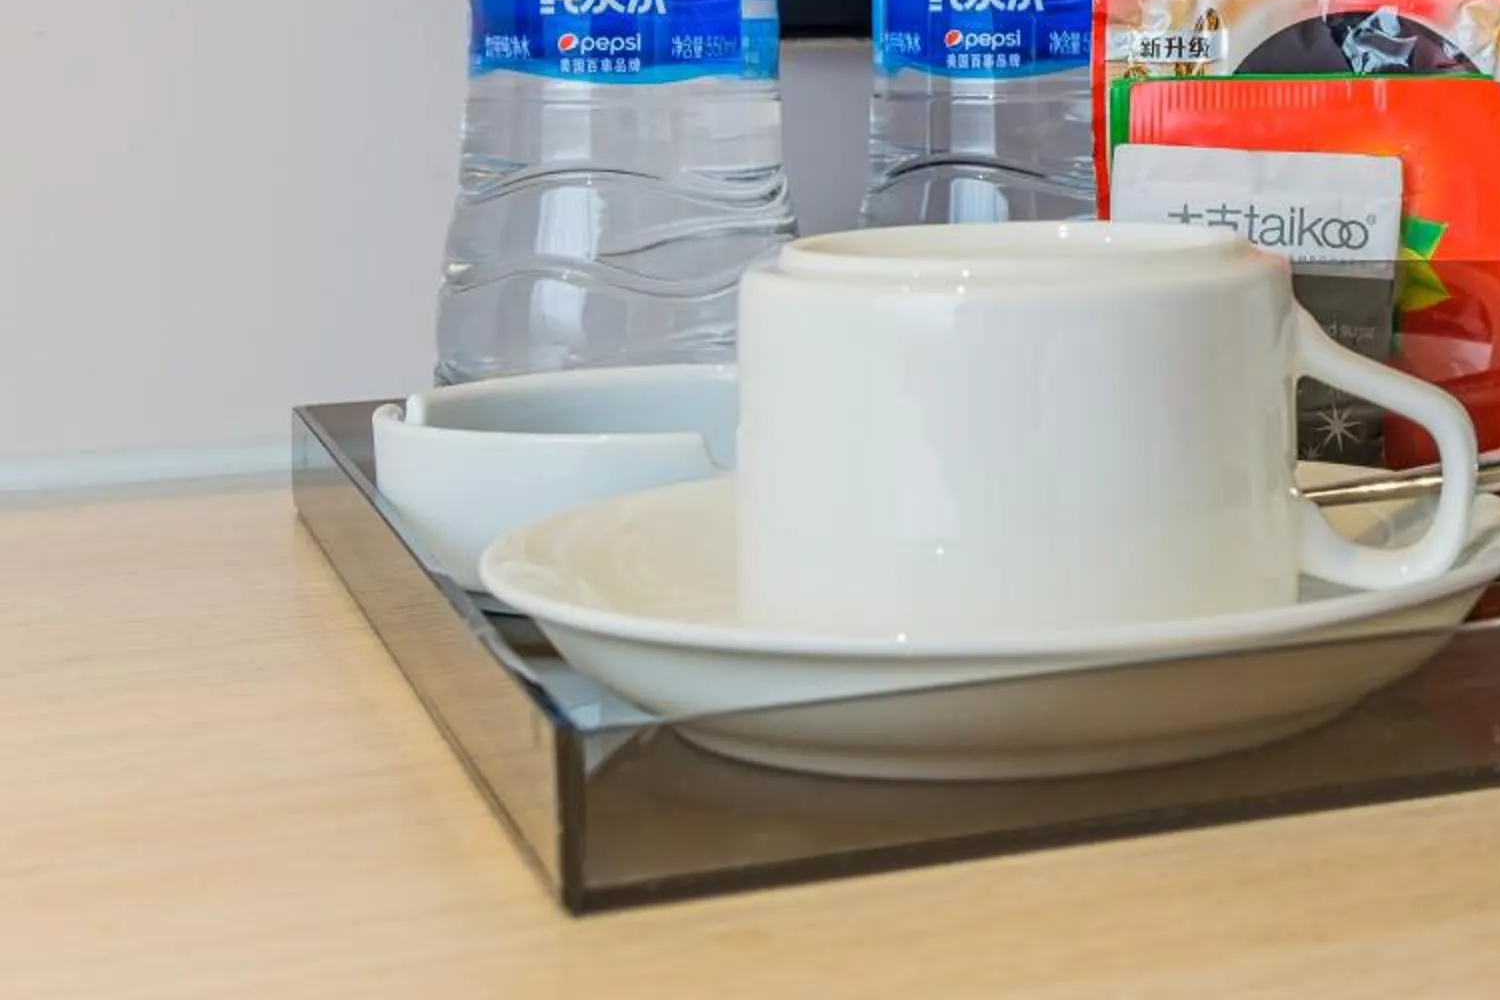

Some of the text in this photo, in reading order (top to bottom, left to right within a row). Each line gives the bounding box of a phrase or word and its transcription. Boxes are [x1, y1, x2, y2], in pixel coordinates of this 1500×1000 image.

[580, 32, 642, 55] pepsi
[964, 29, 1021, 50] pepsi
[1140, 35, 1210, 58] 新升级
